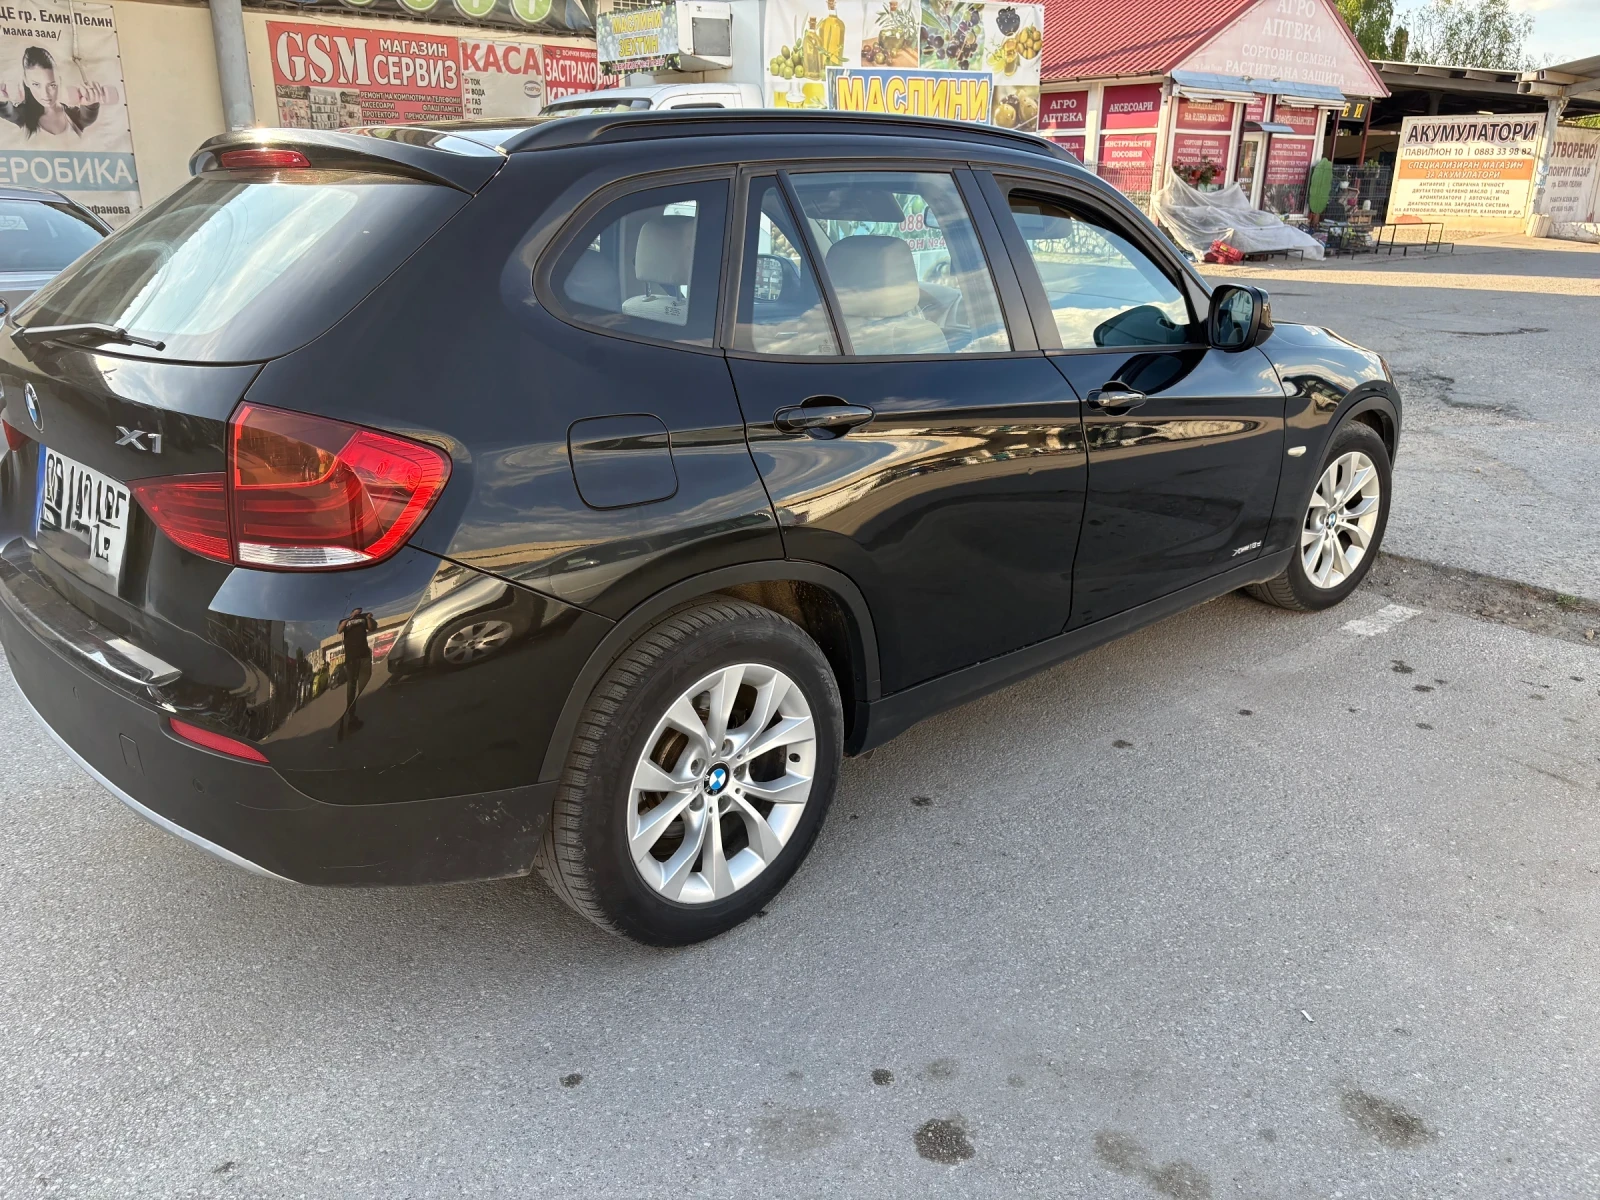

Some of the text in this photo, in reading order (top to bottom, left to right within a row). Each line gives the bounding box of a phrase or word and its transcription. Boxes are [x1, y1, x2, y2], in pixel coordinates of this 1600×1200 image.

[1276, 0, 1315, 18] АГРО
[18, 10, 36, 23] гр.
[40, 10, 70, 24] Елин
[74, 12, 113, 28] Пелин
[612, 10, 662, 34] МАСЛИНИ
[1262, 19, 1322, 42] АПТЕКА
[379, 38, 448, 58] МАГАЗИН
[619, 35, 659, 57] ЗЕХТИН
[276, 31, 372, 86] GSM
[461, 42, 542, 76] КАСА
[1242, 44, 1337, 68] СОРТОВИ СЕМЕНА
[373, 54, 458, 89] СЕРВИЗ
[1226, 60, 1298, 79] РАСТИТЕЛНА
[1302, 69, 1344, 85] ЗАЩИТА
[470, 78, 480, 86] ТОК
[471, 88, 486, 96] ВОДА
[837, 77, 988, 121] МАСЛИНИ
[1050, 99, 1077, 110] АГРО
[1109, 102, 1153, 112] АКСЕСОАРИ
[1042, 112, 1083, 122] АПТЕКА
[1407, 122, 1538, 142] АКУМУЛАТОРИ
[1404, 148, 1453, 156] ПАВИЛИОН
[1454, 148, 1464, 156] 10
[1474, 148, 1494, 156] 0883
[1496, 148, 1506, 156] 33
[1408, 161, 1524, 170] СПЕЦИАЛИЗИРАН МАГАЗИН
[1426, 170, 1501, 178] ЗА АКУМУЛАТОРИ
[1572, 167, 1591, 178] ПАЗАР
[900, 213, 929, 232] 088
[907, 239, 924, 250] ОН
[115, 425, 162, 454] X1
